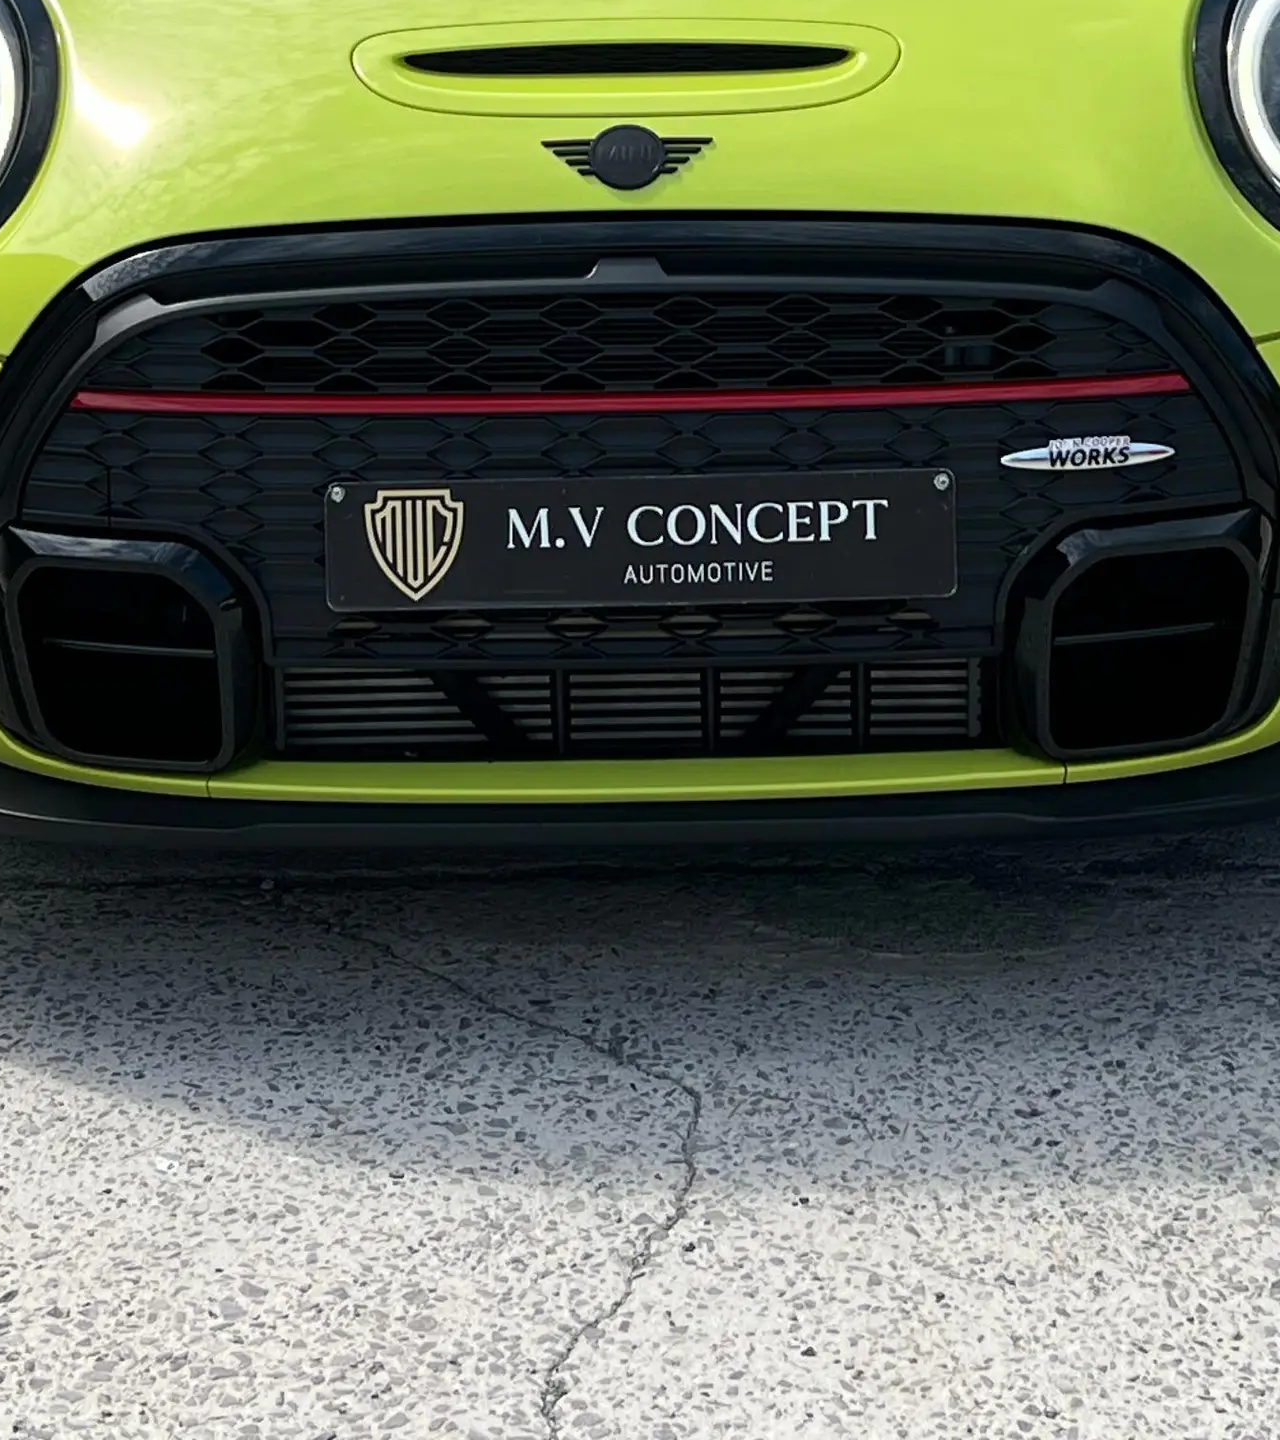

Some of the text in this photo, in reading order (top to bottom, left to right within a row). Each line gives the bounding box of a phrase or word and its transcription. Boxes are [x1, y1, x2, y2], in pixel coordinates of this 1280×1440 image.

[1049, 446, 1131, 468] WORKS
[506, 498, 889, 550] M.V CONCEPT
[623, 560, 774, 585] AUTOMOTIVE
